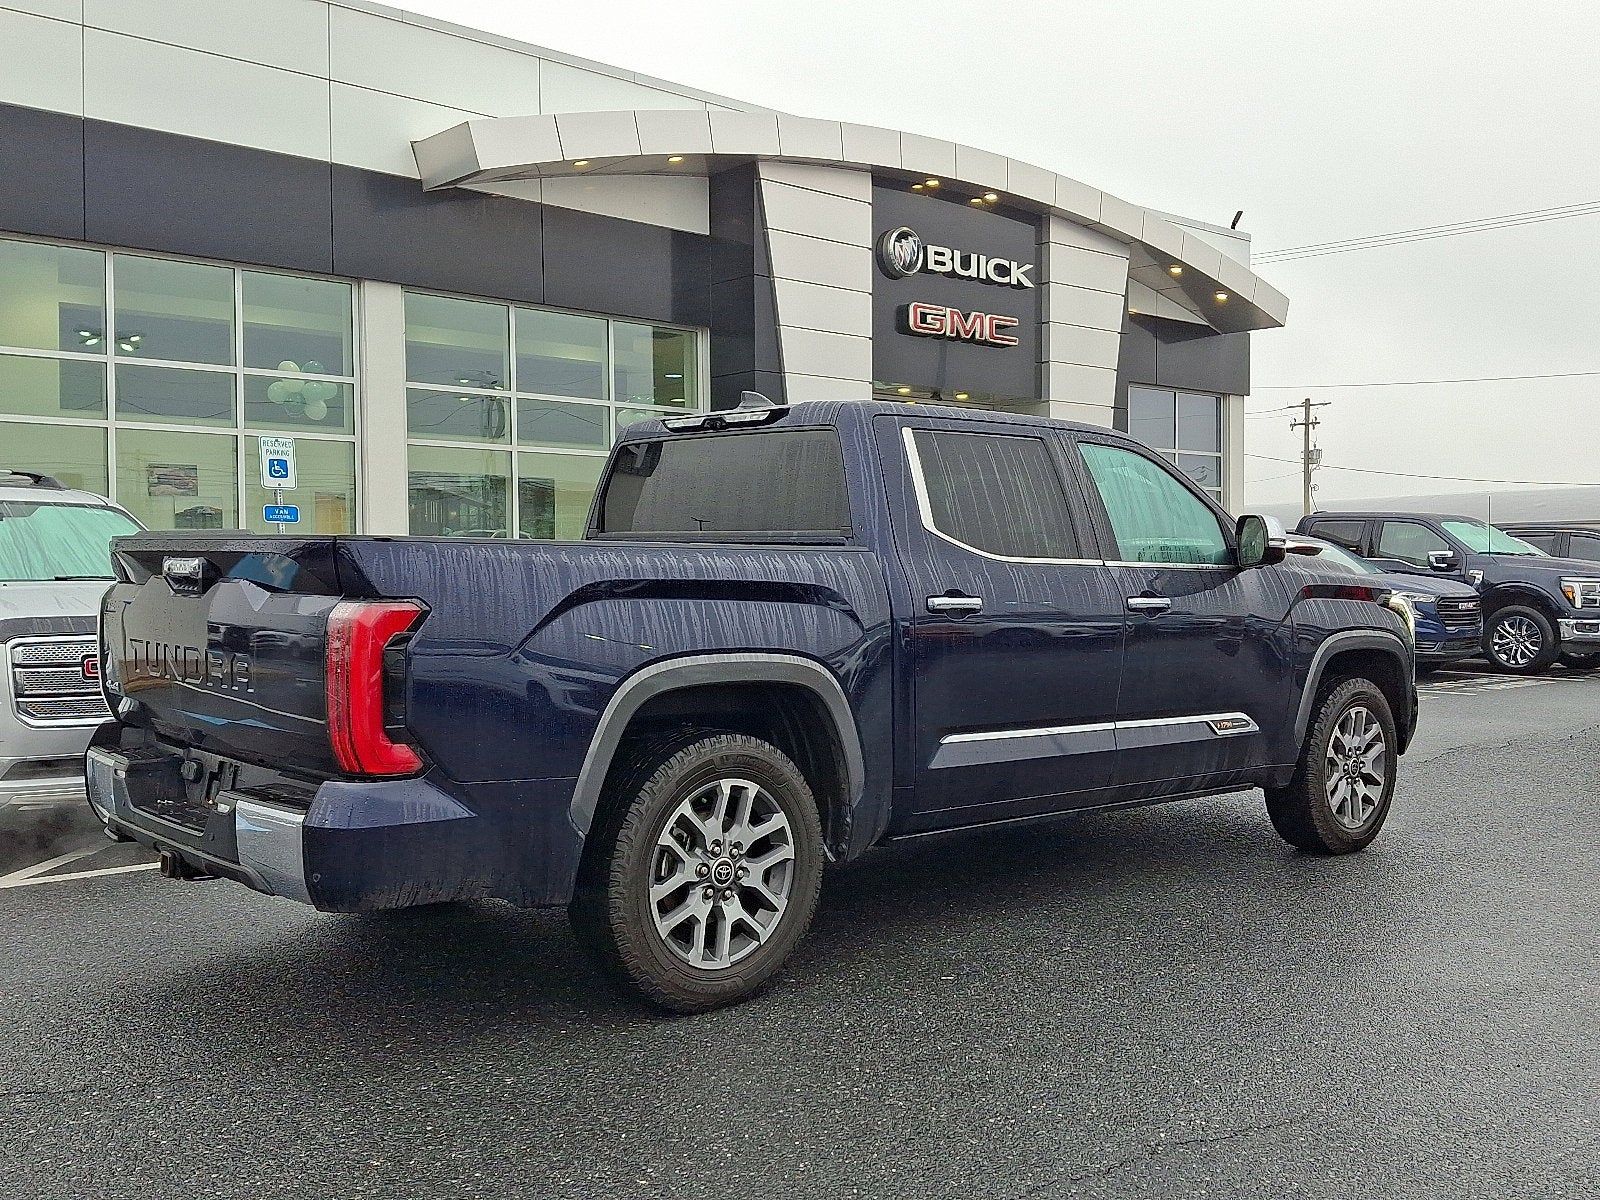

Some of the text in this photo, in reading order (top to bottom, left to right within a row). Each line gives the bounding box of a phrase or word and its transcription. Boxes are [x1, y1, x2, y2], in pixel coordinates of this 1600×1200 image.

[927, 244, 1035, 288] BUICK
[909, 301, 1019, 345] GMC
[262, 439, 292, 449] RESERVED
[265, 448, 290, 457] PARKING
[129, 637, 255, 693] TUNDRA
